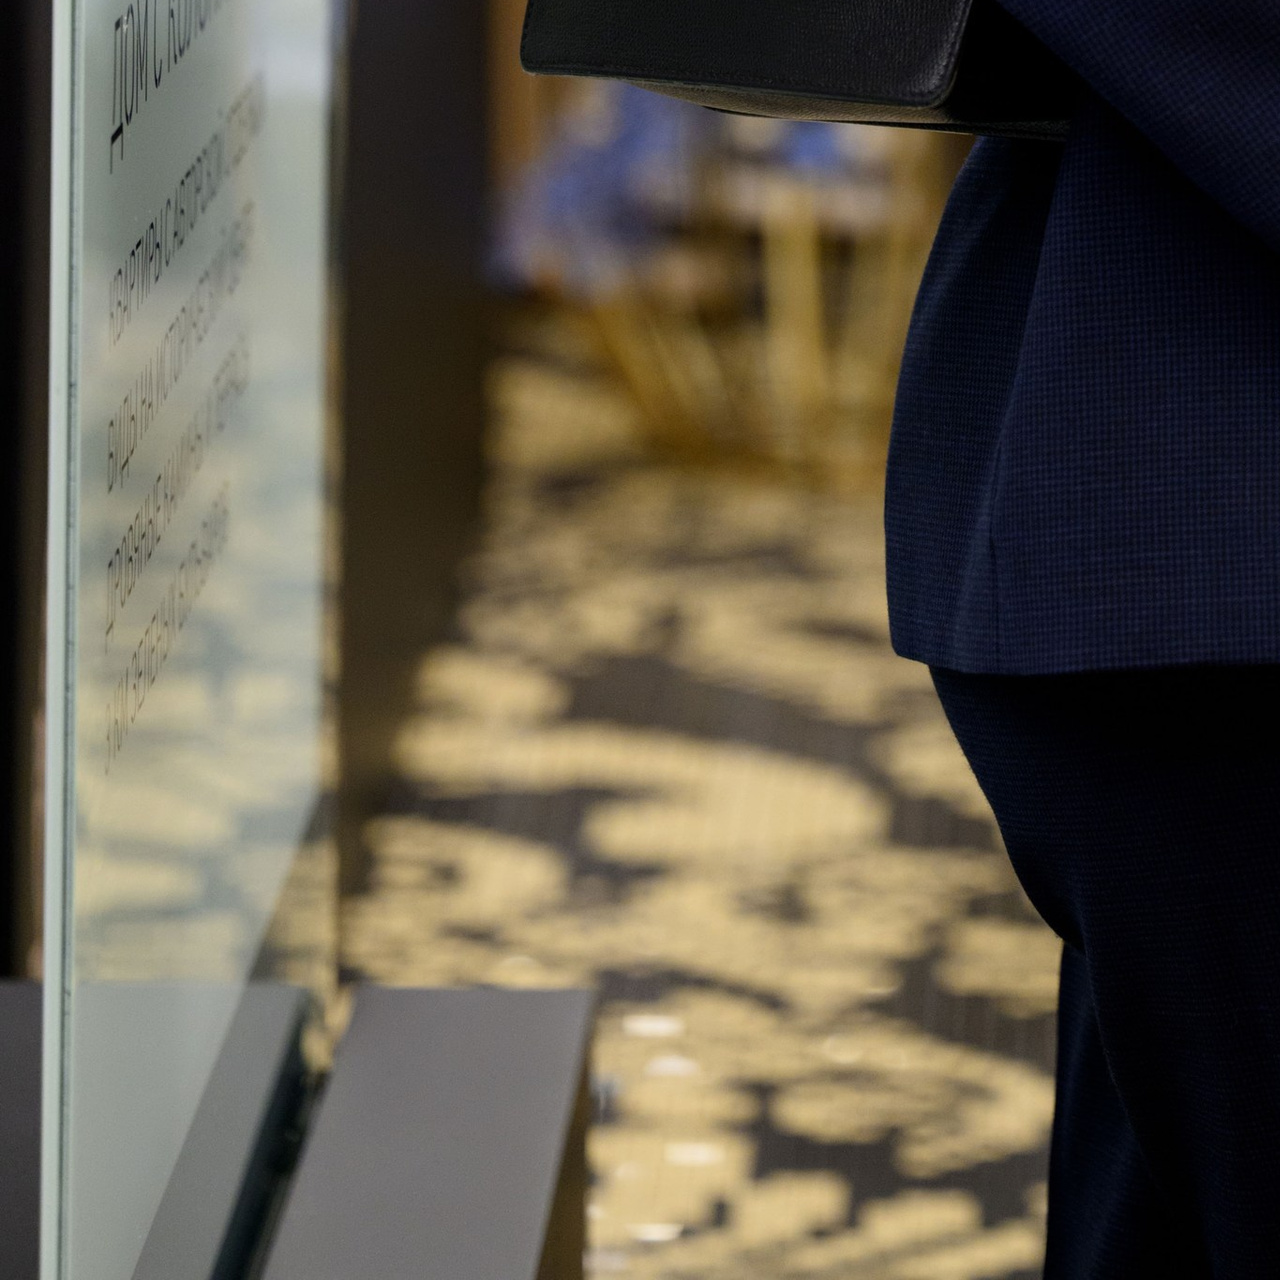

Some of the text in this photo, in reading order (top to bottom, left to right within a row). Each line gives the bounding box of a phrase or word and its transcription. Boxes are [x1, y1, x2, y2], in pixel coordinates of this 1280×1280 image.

[108, 208, 163, 352] КВАРТИРЫ
[165, 198, 172, 267] С
[107, 378, 138, 494] ВИДЫ
[140, 357, 153, 440] НА
[105, 474, 161, 656] ДРОВЯНЫЕ
